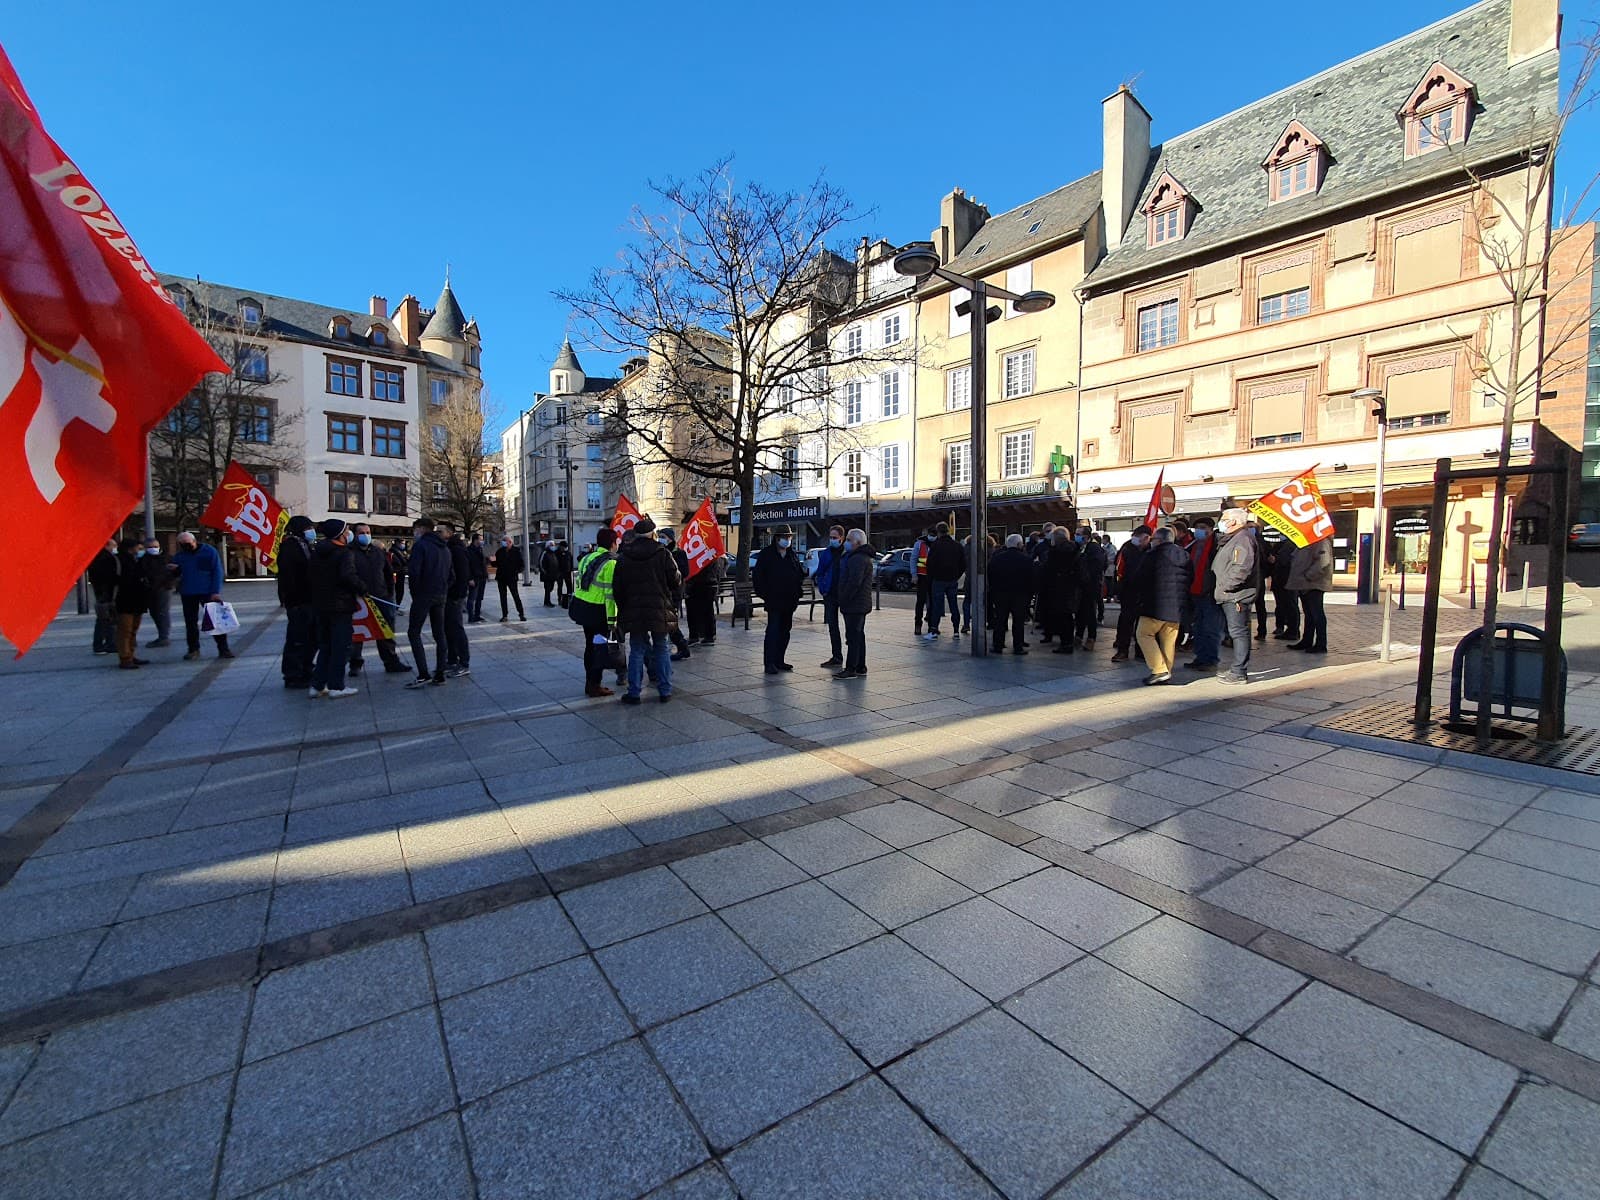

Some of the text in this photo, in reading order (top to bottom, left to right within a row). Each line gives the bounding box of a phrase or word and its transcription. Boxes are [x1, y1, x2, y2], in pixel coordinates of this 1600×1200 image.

[224, 487, 272, 544] cgt
[787, 506, 817, 518] Habitat
[1274, 480, 1333, 538] cgt
[684, 520, 716, 568] cgt
